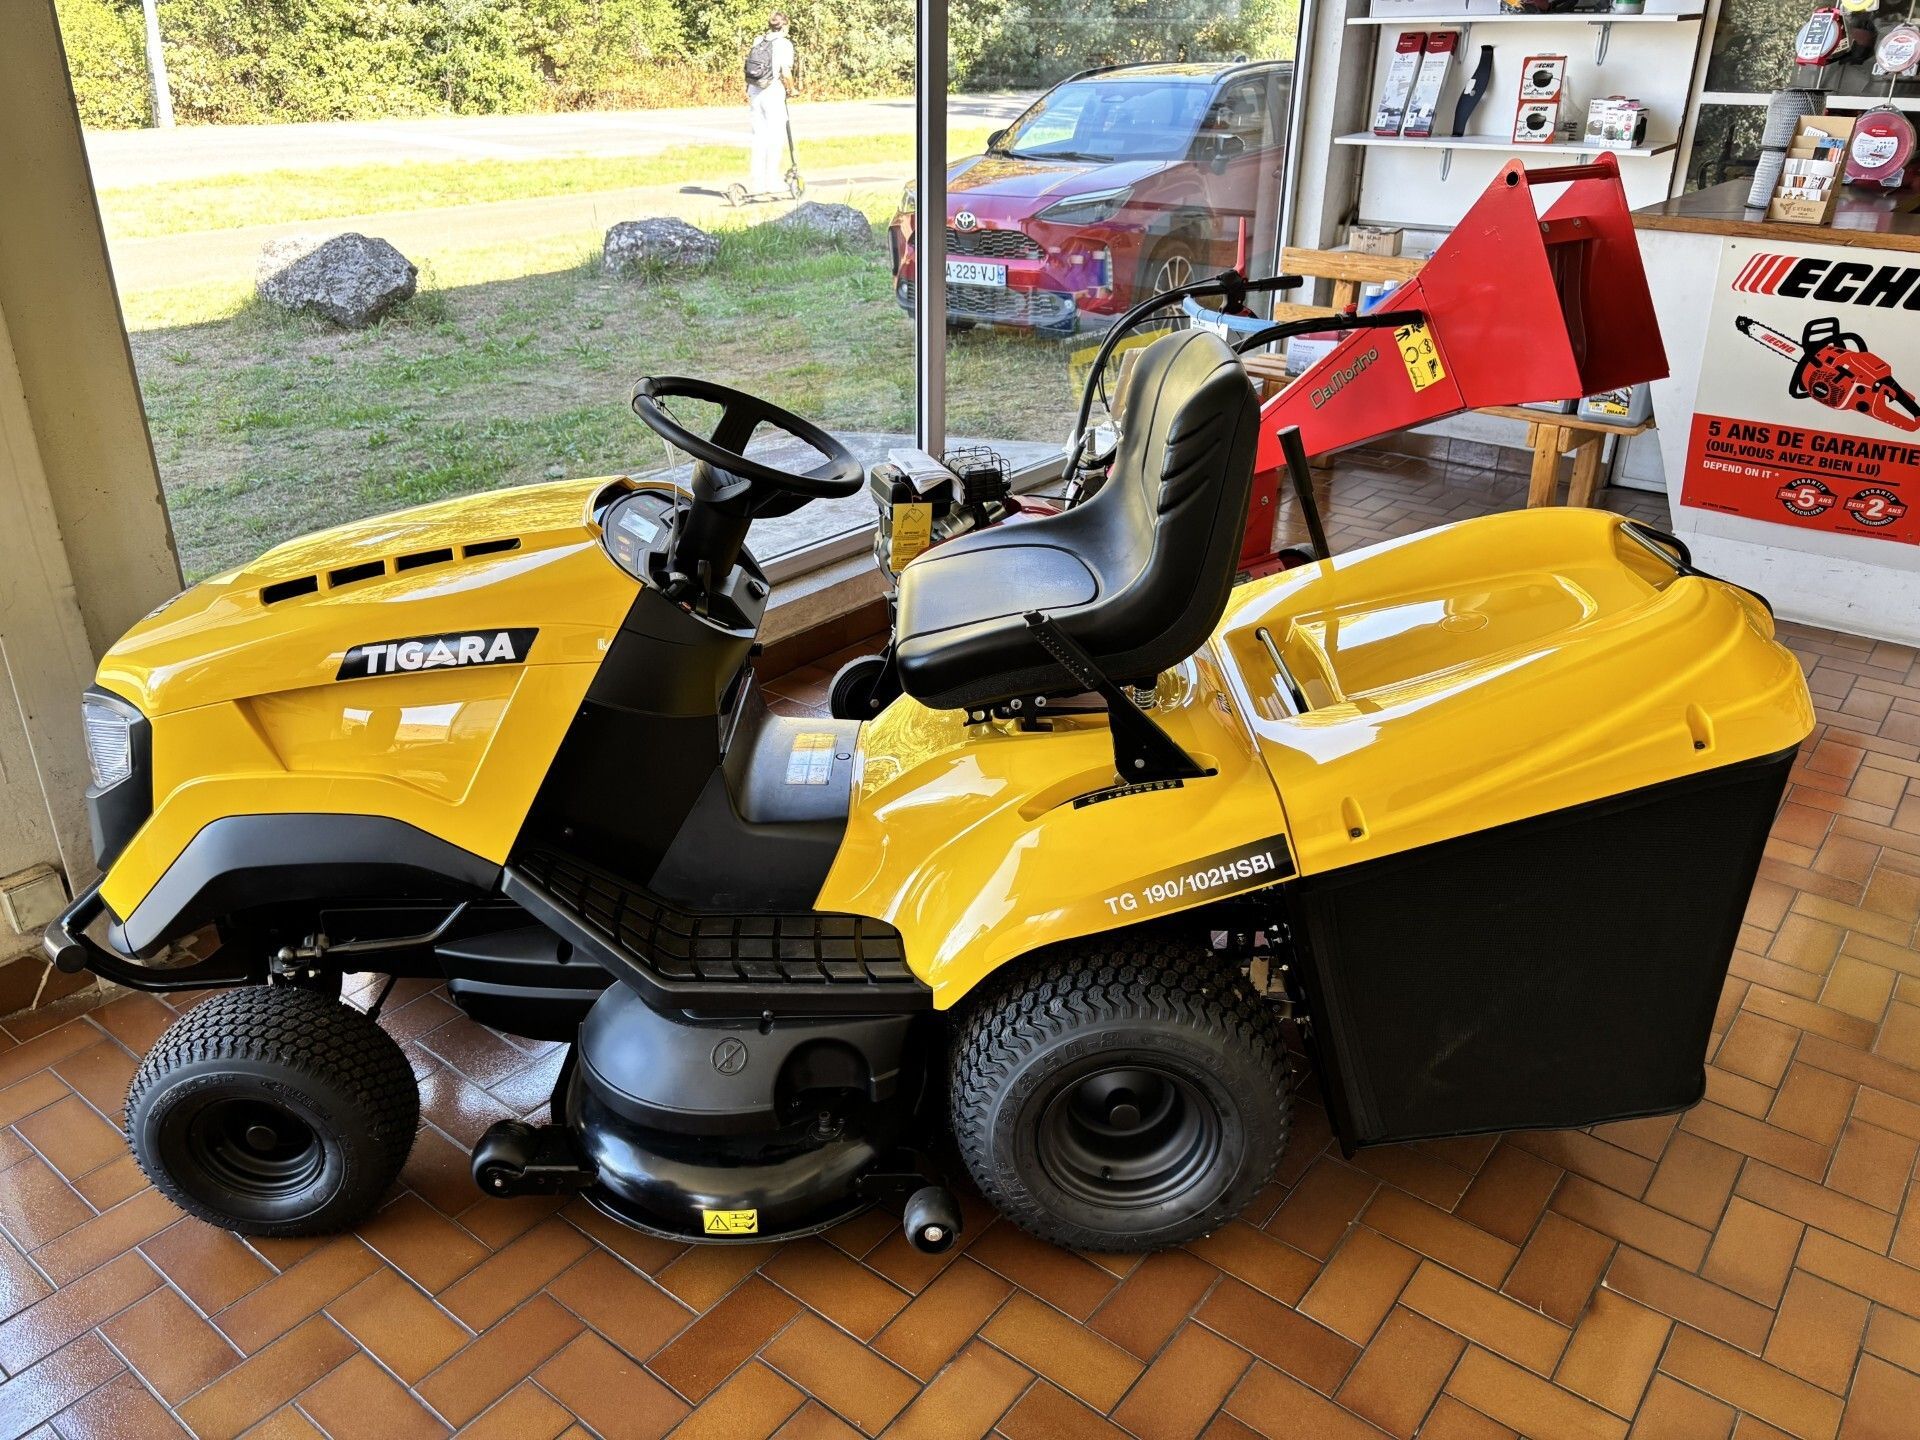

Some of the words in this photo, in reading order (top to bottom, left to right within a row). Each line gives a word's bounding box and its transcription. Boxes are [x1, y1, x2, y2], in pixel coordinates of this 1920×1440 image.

[1777, 258, 1920, 310] ECH
[1767, 336, 1797, 354] ECHO
[1708, 421, 1722, 437] 5
[1727, 424, 1771, 444] ANS
[1776, 430, 1806, 449] DE
[1811, 435, 1920, 466] GARANTIE
[1703, 460, 1743, 474] DEPEND
[1744, 467, 1760, 477] ON
[1761, 470, 1773, 479] IT
[1778, 451, 1815, 466] AVEZ
[1818, 457, 1853, 472] BIEN
[1857, 462, 1881, 477] LU)
[1791, 479, 1827, 492] GARANTIE
[1781, 491, 1797, 500] CINQ
[1797, 488, 1816, 507] 5
[1860, 489, 1897, 502] GARANTIE
[1785, 501, 1824, 516] PARTICULIERS
[1847, 501, 1866, 509] DEUX
[1866, 498, 1885, 517] 2
[362, 632, 516, 674] TIGARA
[1104, 892, 1138, 915] TG
[1142, 852, 1276, 905] 190/102HSBI
